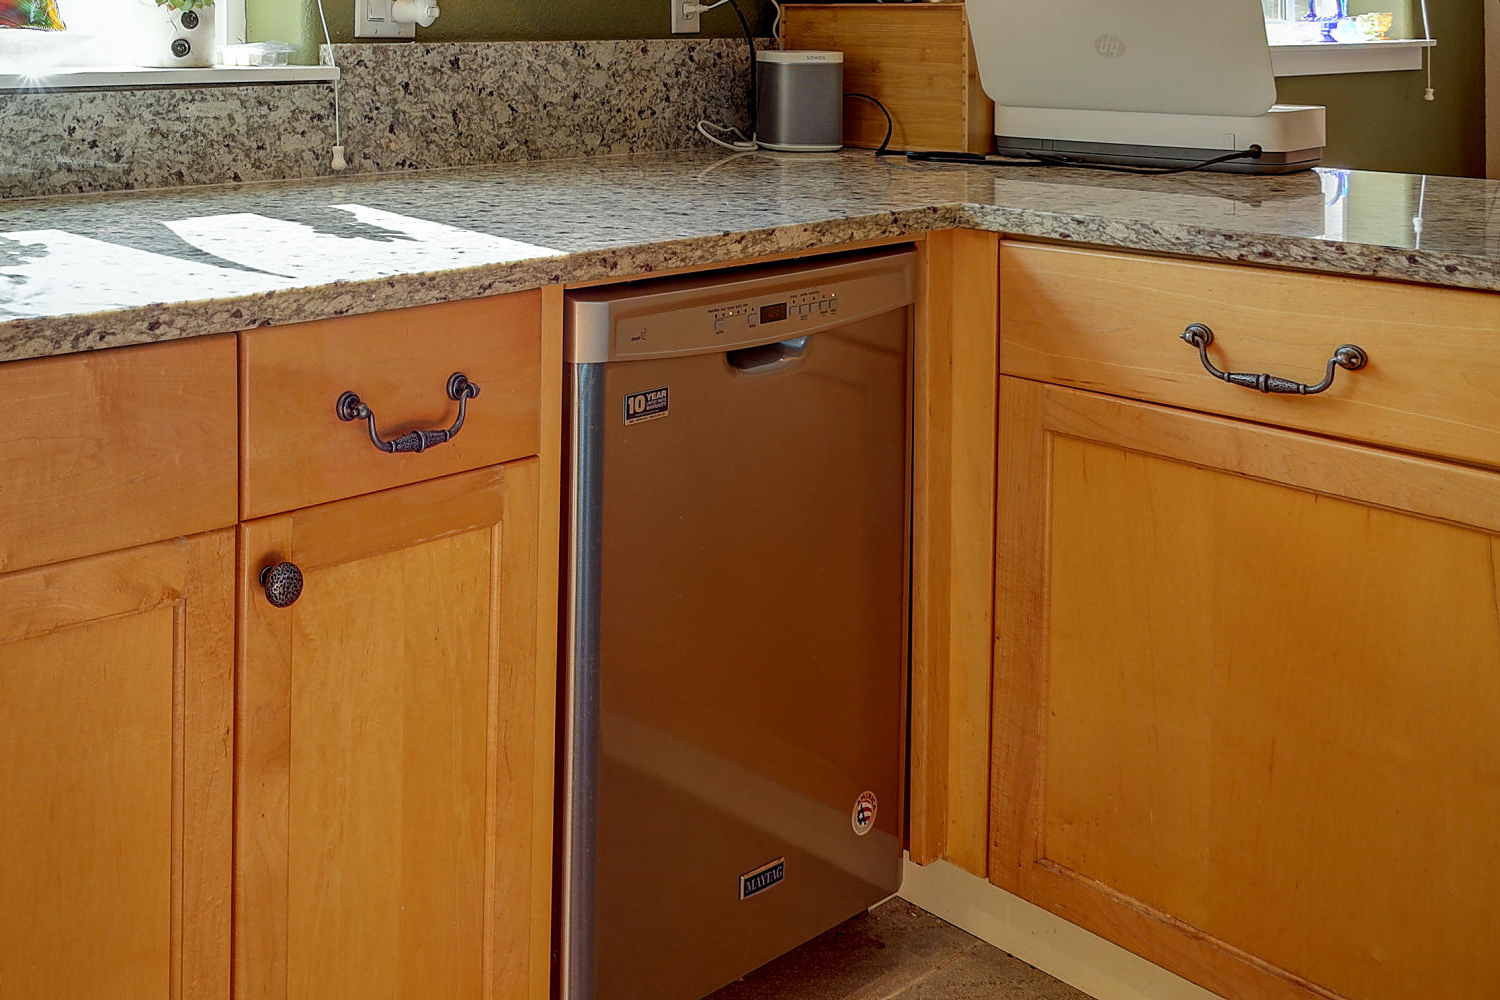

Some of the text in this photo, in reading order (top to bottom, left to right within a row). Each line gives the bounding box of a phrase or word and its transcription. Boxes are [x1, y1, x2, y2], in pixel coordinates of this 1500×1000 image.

[628, 395, 645, 414] 10
[646, 390, 667, 400] YEAR
[745, 866, 783, 893] MAYTAG
